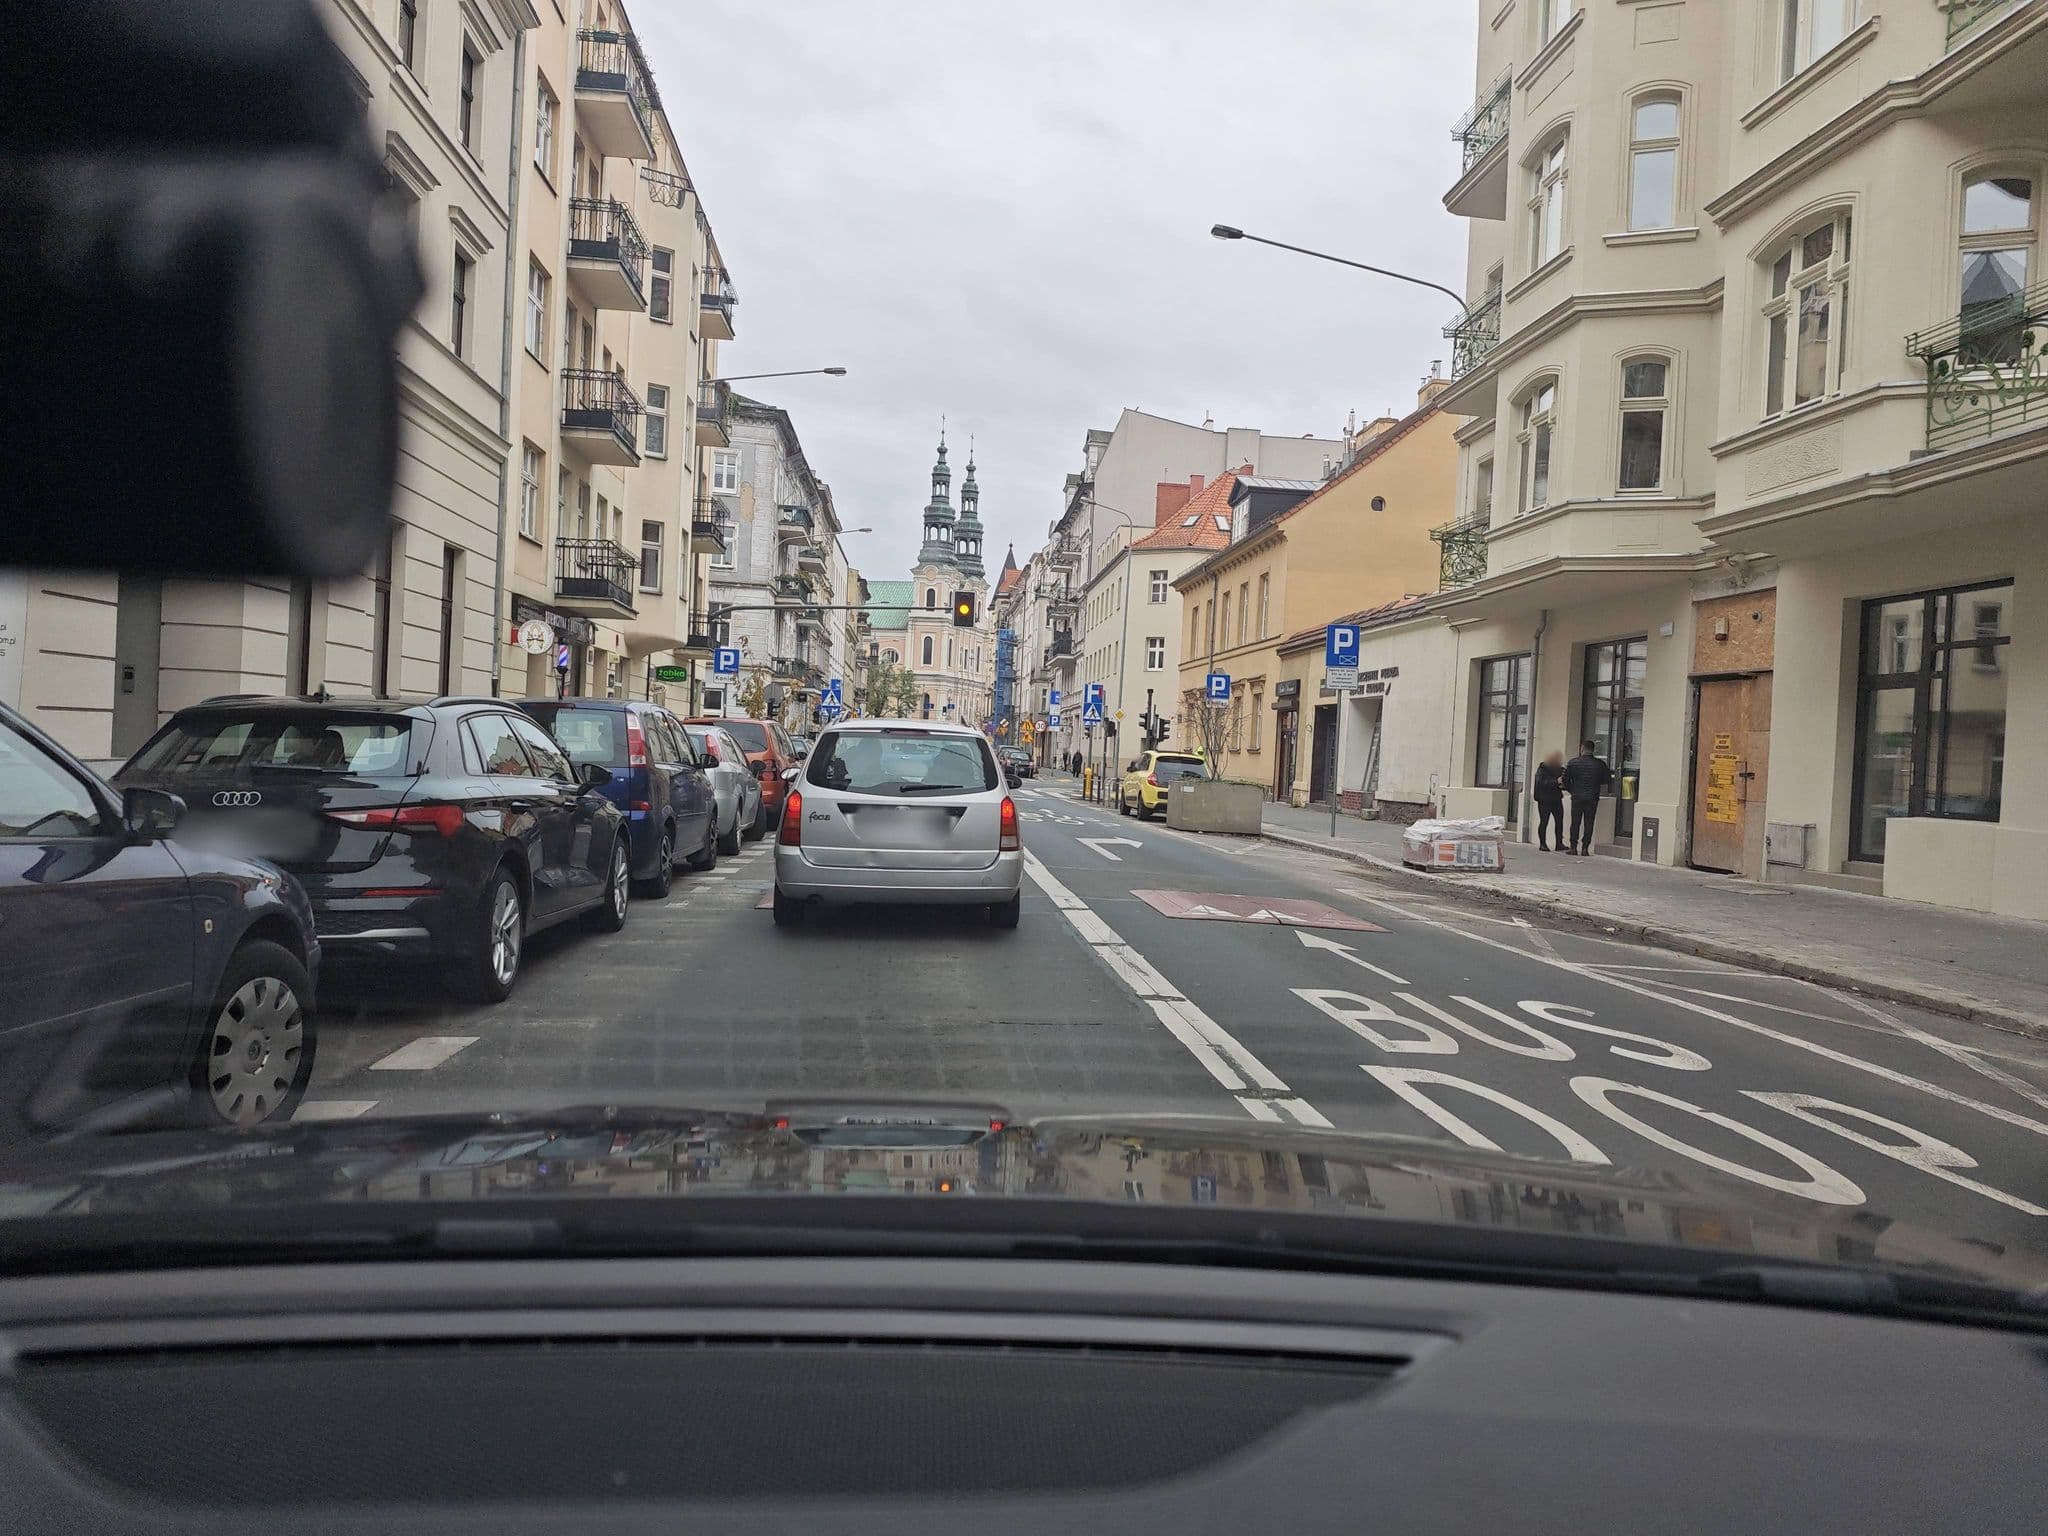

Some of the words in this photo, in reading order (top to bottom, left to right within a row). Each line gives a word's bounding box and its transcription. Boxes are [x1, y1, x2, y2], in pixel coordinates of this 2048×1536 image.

[1334, 628, 1354, 655] P
[719, 651, 735, 671] P
[1211, 676, 1226, 696] P
[1289, 987, 1712, 1071] BUS
